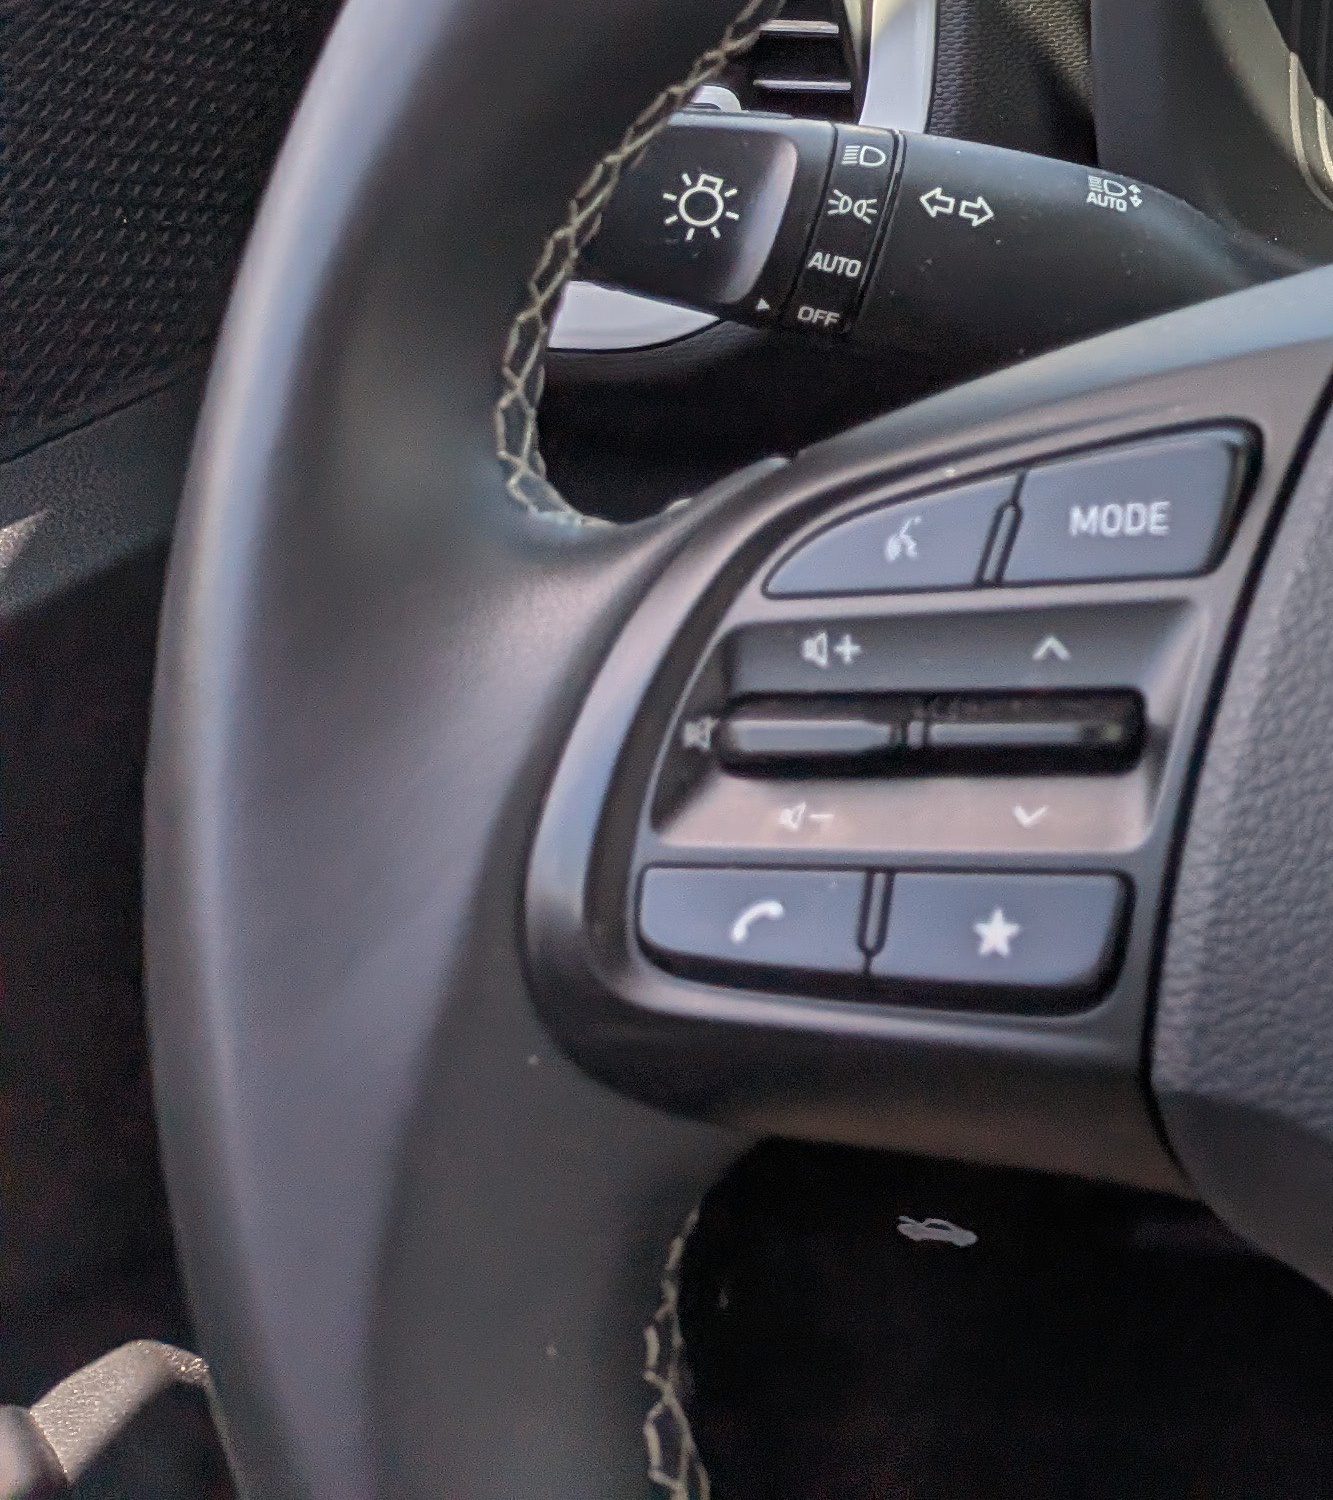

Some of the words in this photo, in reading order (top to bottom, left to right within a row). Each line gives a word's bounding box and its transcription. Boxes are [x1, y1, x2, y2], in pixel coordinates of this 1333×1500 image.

[1086, 191, 1129, 212] AUTO
[807, 250, 862, 278] AUTO
[797, 306, 840, 328] OFF
[1069, 500, 1171, 537] MODE
